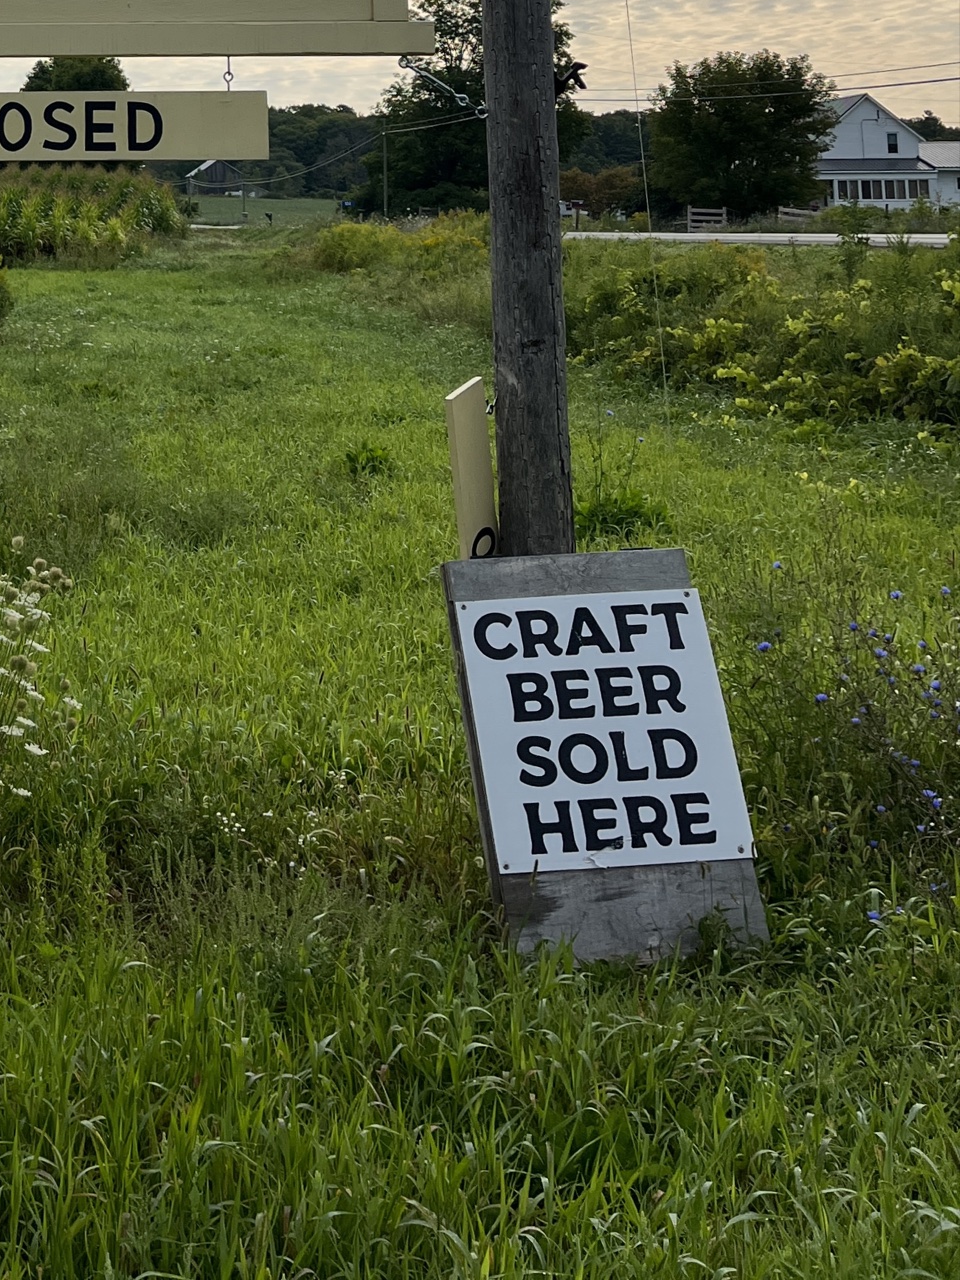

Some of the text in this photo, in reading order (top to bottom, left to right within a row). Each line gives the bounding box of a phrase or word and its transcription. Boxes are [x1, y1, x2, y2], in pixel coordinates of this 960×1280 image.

[472, 602, 690, 661] CRAFT
[505, 664, 688, 723] BEER
[515, 728, 699, 788] SOLD
[522, 792, 718, 856] HERE
